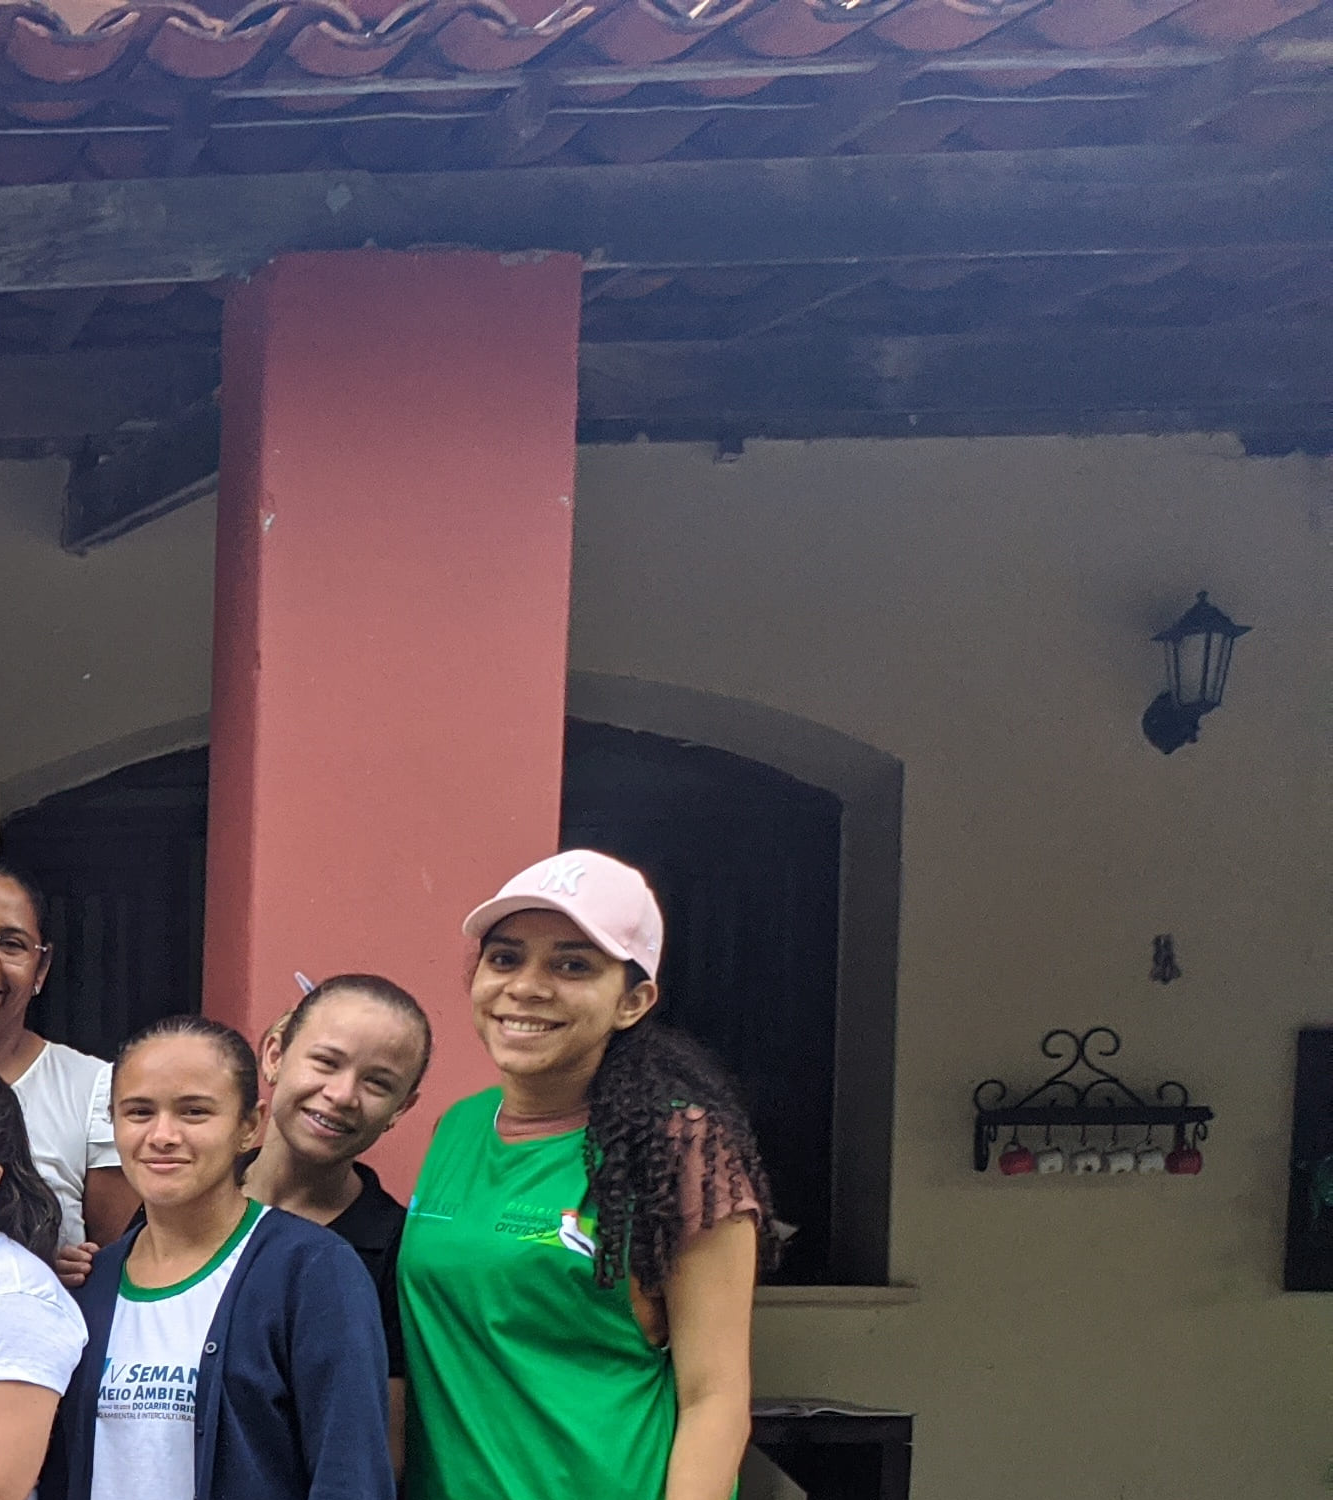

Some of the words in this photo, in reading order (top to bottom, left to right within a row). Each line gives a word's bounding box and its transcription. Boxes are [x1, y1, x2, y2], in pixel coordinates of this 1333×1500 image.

[125, 1363, 200, 1384] SEMAN
[133, 1385, 197, 1402] AMBIEN
[133, 1402, 144, 1410] DO
[145, 1402, 170, 1411] CARIRI
[172, 1403, 196, 1414] ORIE
[141, 1412, 195, 1421] INTERCULTURA
